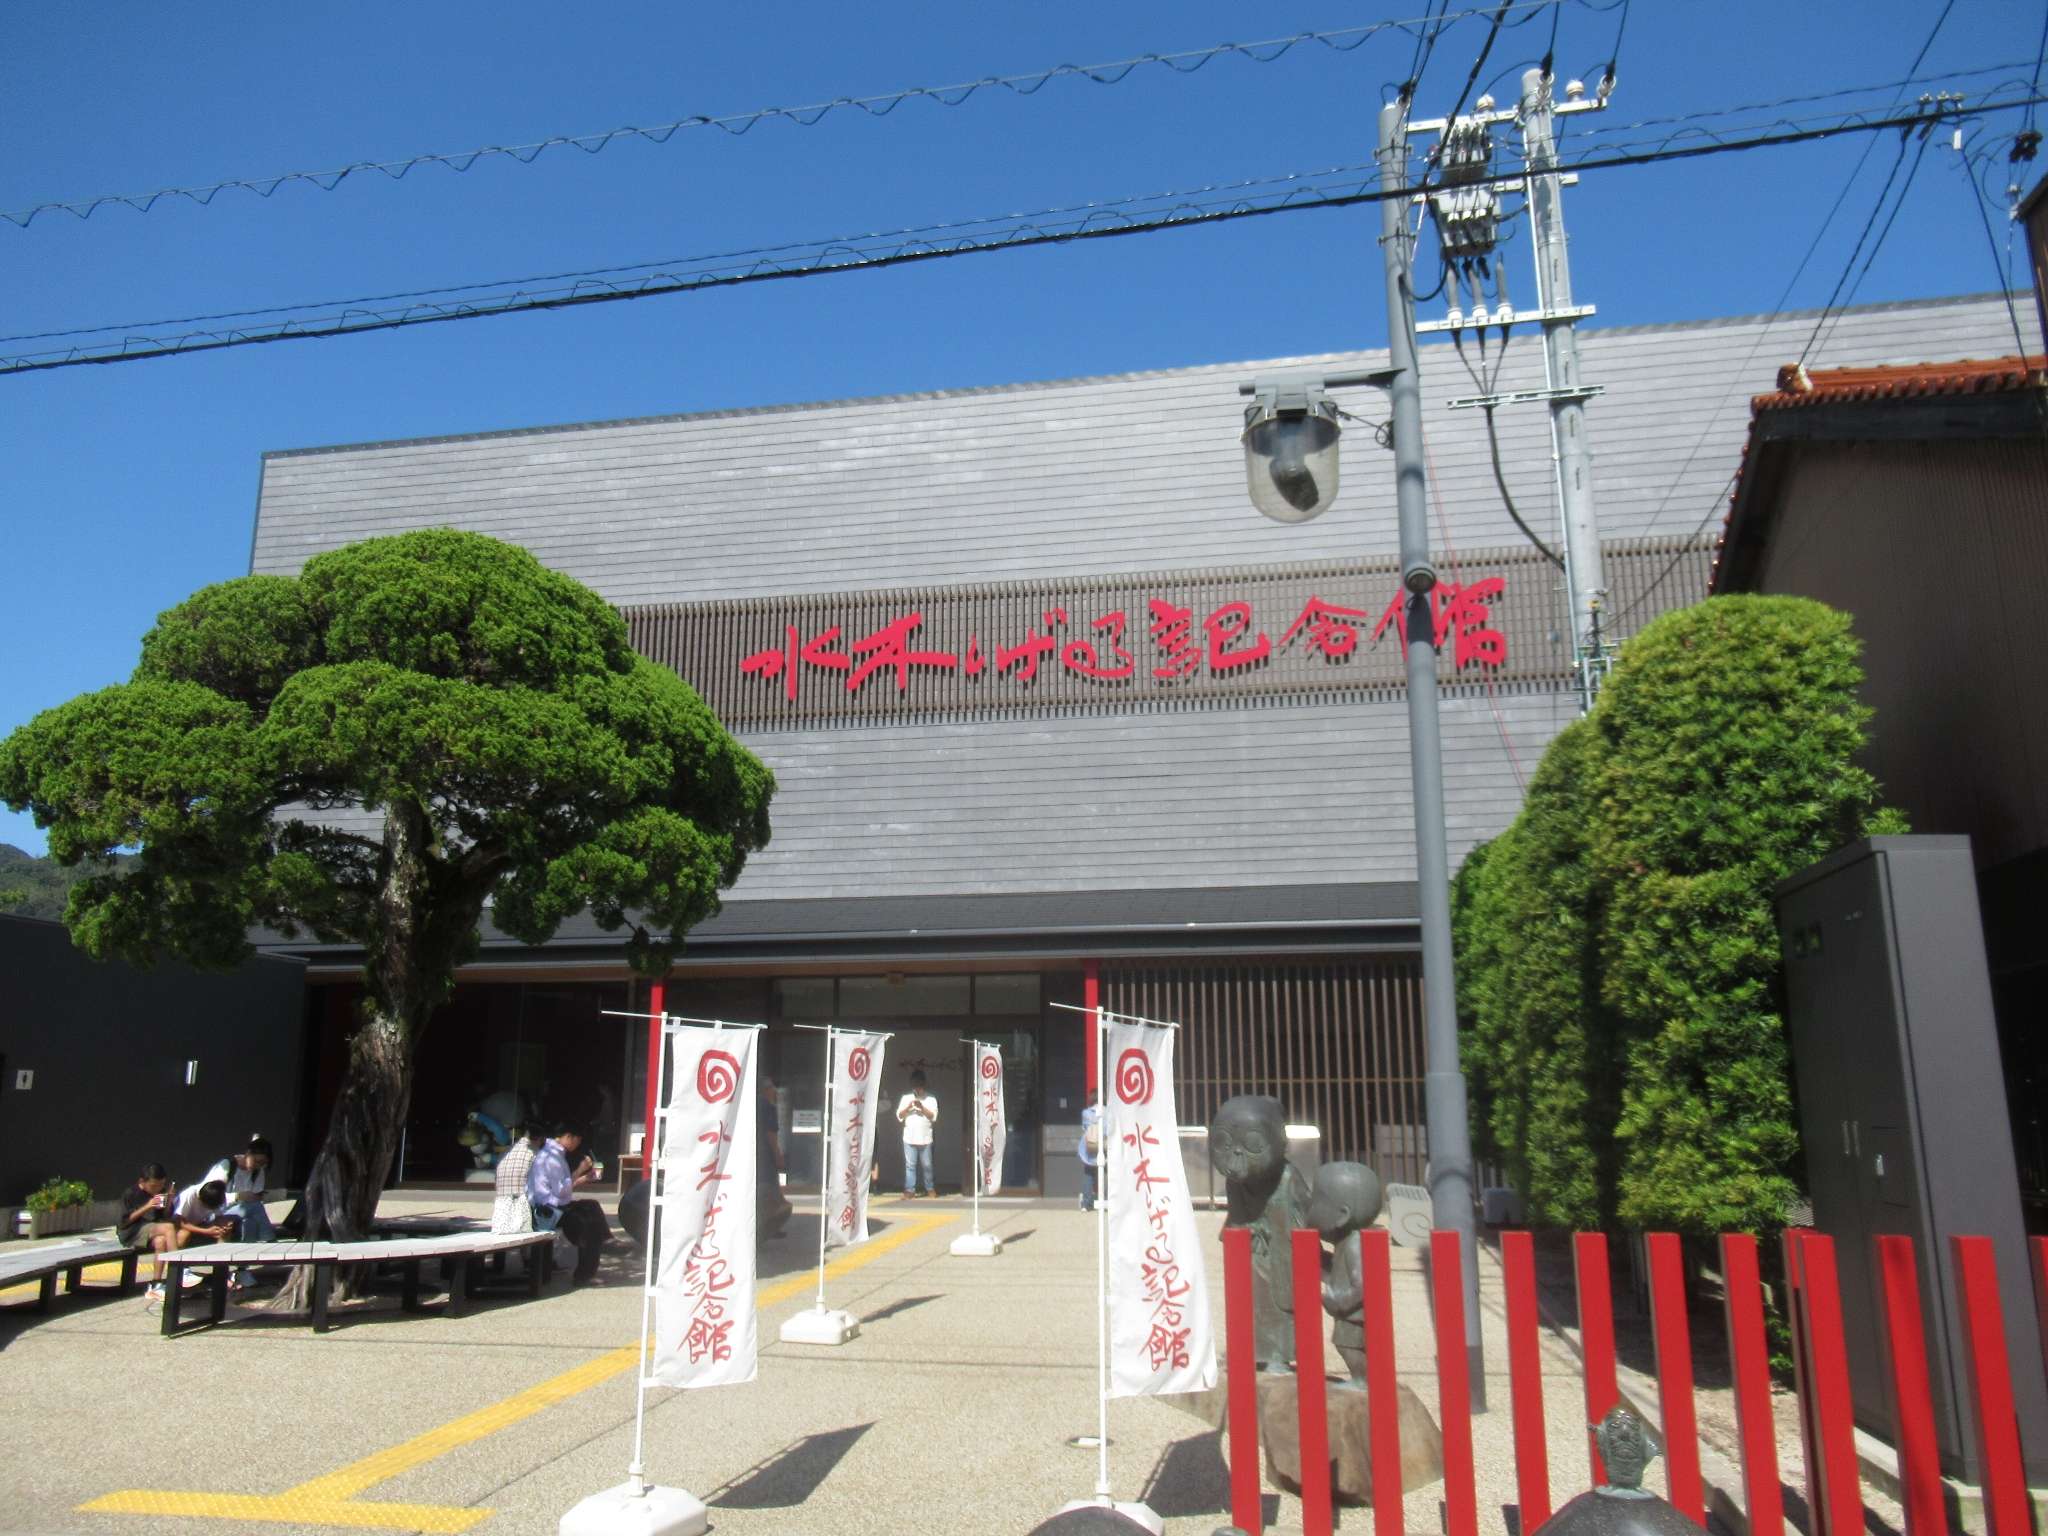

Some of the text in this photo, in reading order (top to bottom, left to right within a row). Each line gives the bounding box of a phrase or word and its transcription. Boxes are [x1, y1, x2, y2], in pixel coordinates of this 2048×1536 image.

[677, 1119, 736, 1365] 水木げる記念館
[1122, 1122, 1192, 1372] 水木しげる記念館
